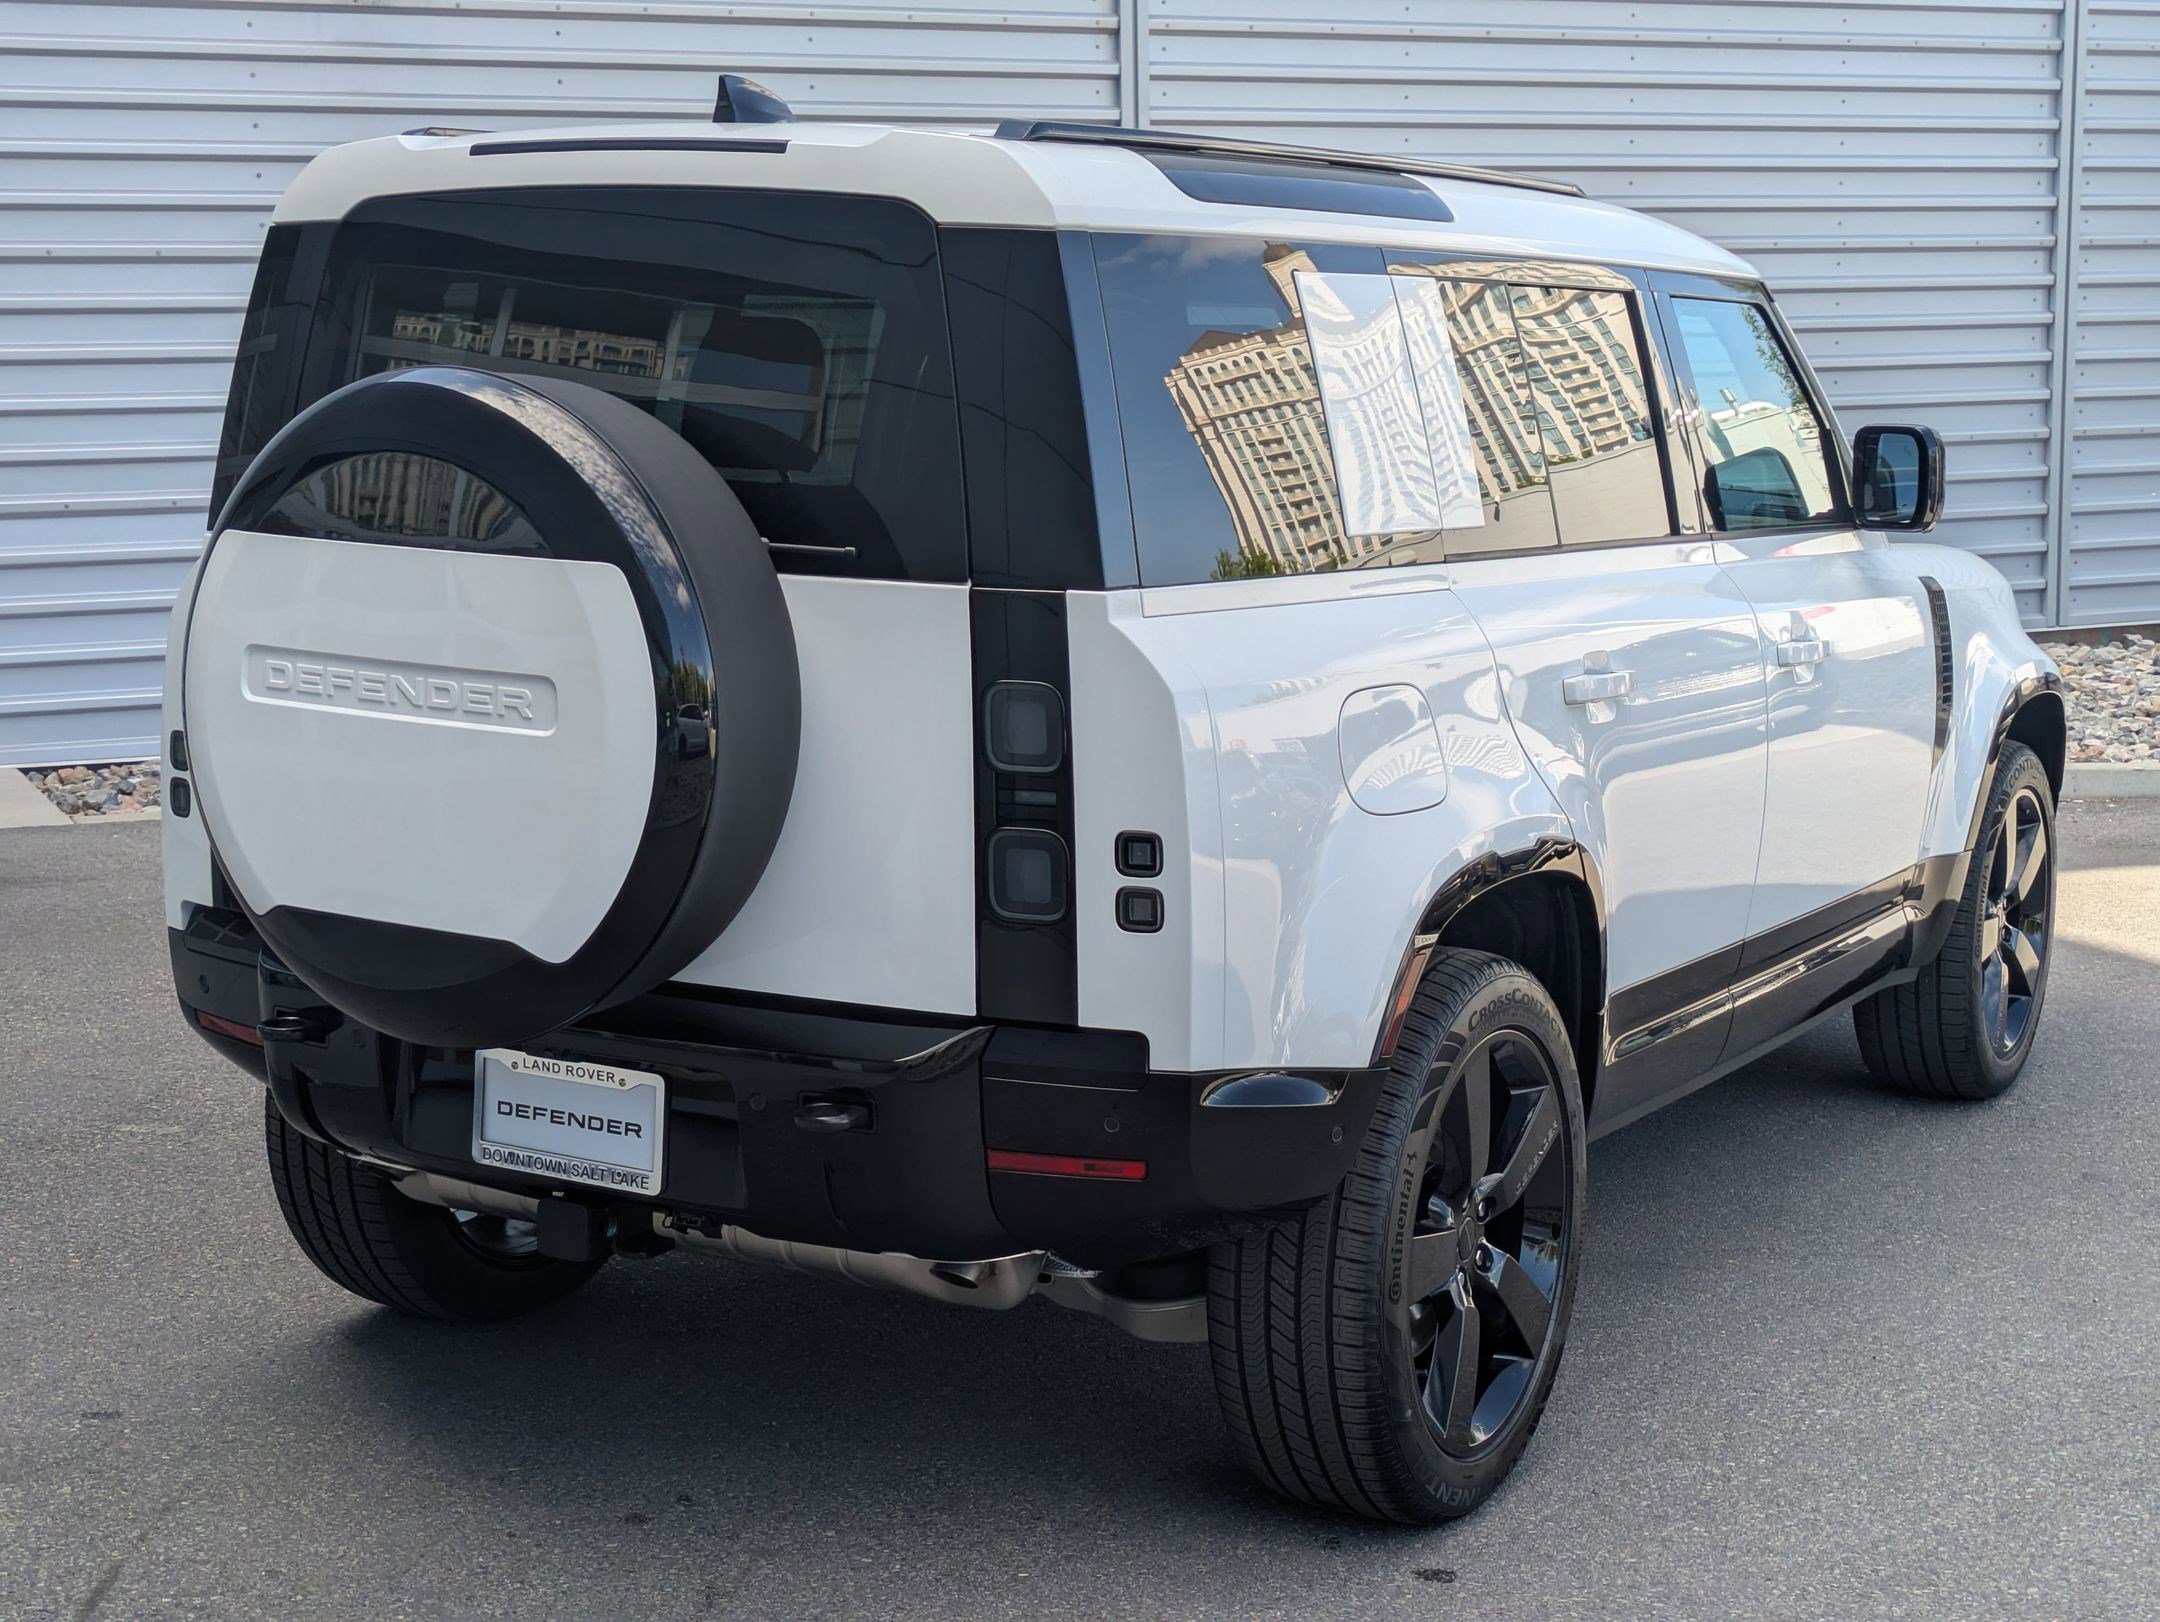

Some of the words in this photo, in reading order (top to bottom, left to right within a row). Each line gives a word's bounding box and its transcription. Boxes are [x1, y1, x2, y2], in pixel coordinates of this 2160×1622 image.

[265, 659, 533, 720] DEFENDER
[523, 1057, 561, 1074] LAND
[566, 1065, 616, 1084] ROVER
[497, 1100, 643, 1139] DEFENDER
[482, 1147, 567, 1175] DOWNTOWN
[571, 1163, 608, 1181] SALT
[610, 1171, 649, 1190] LAKE
[1389, 1168, 1415, 1305] Continental
